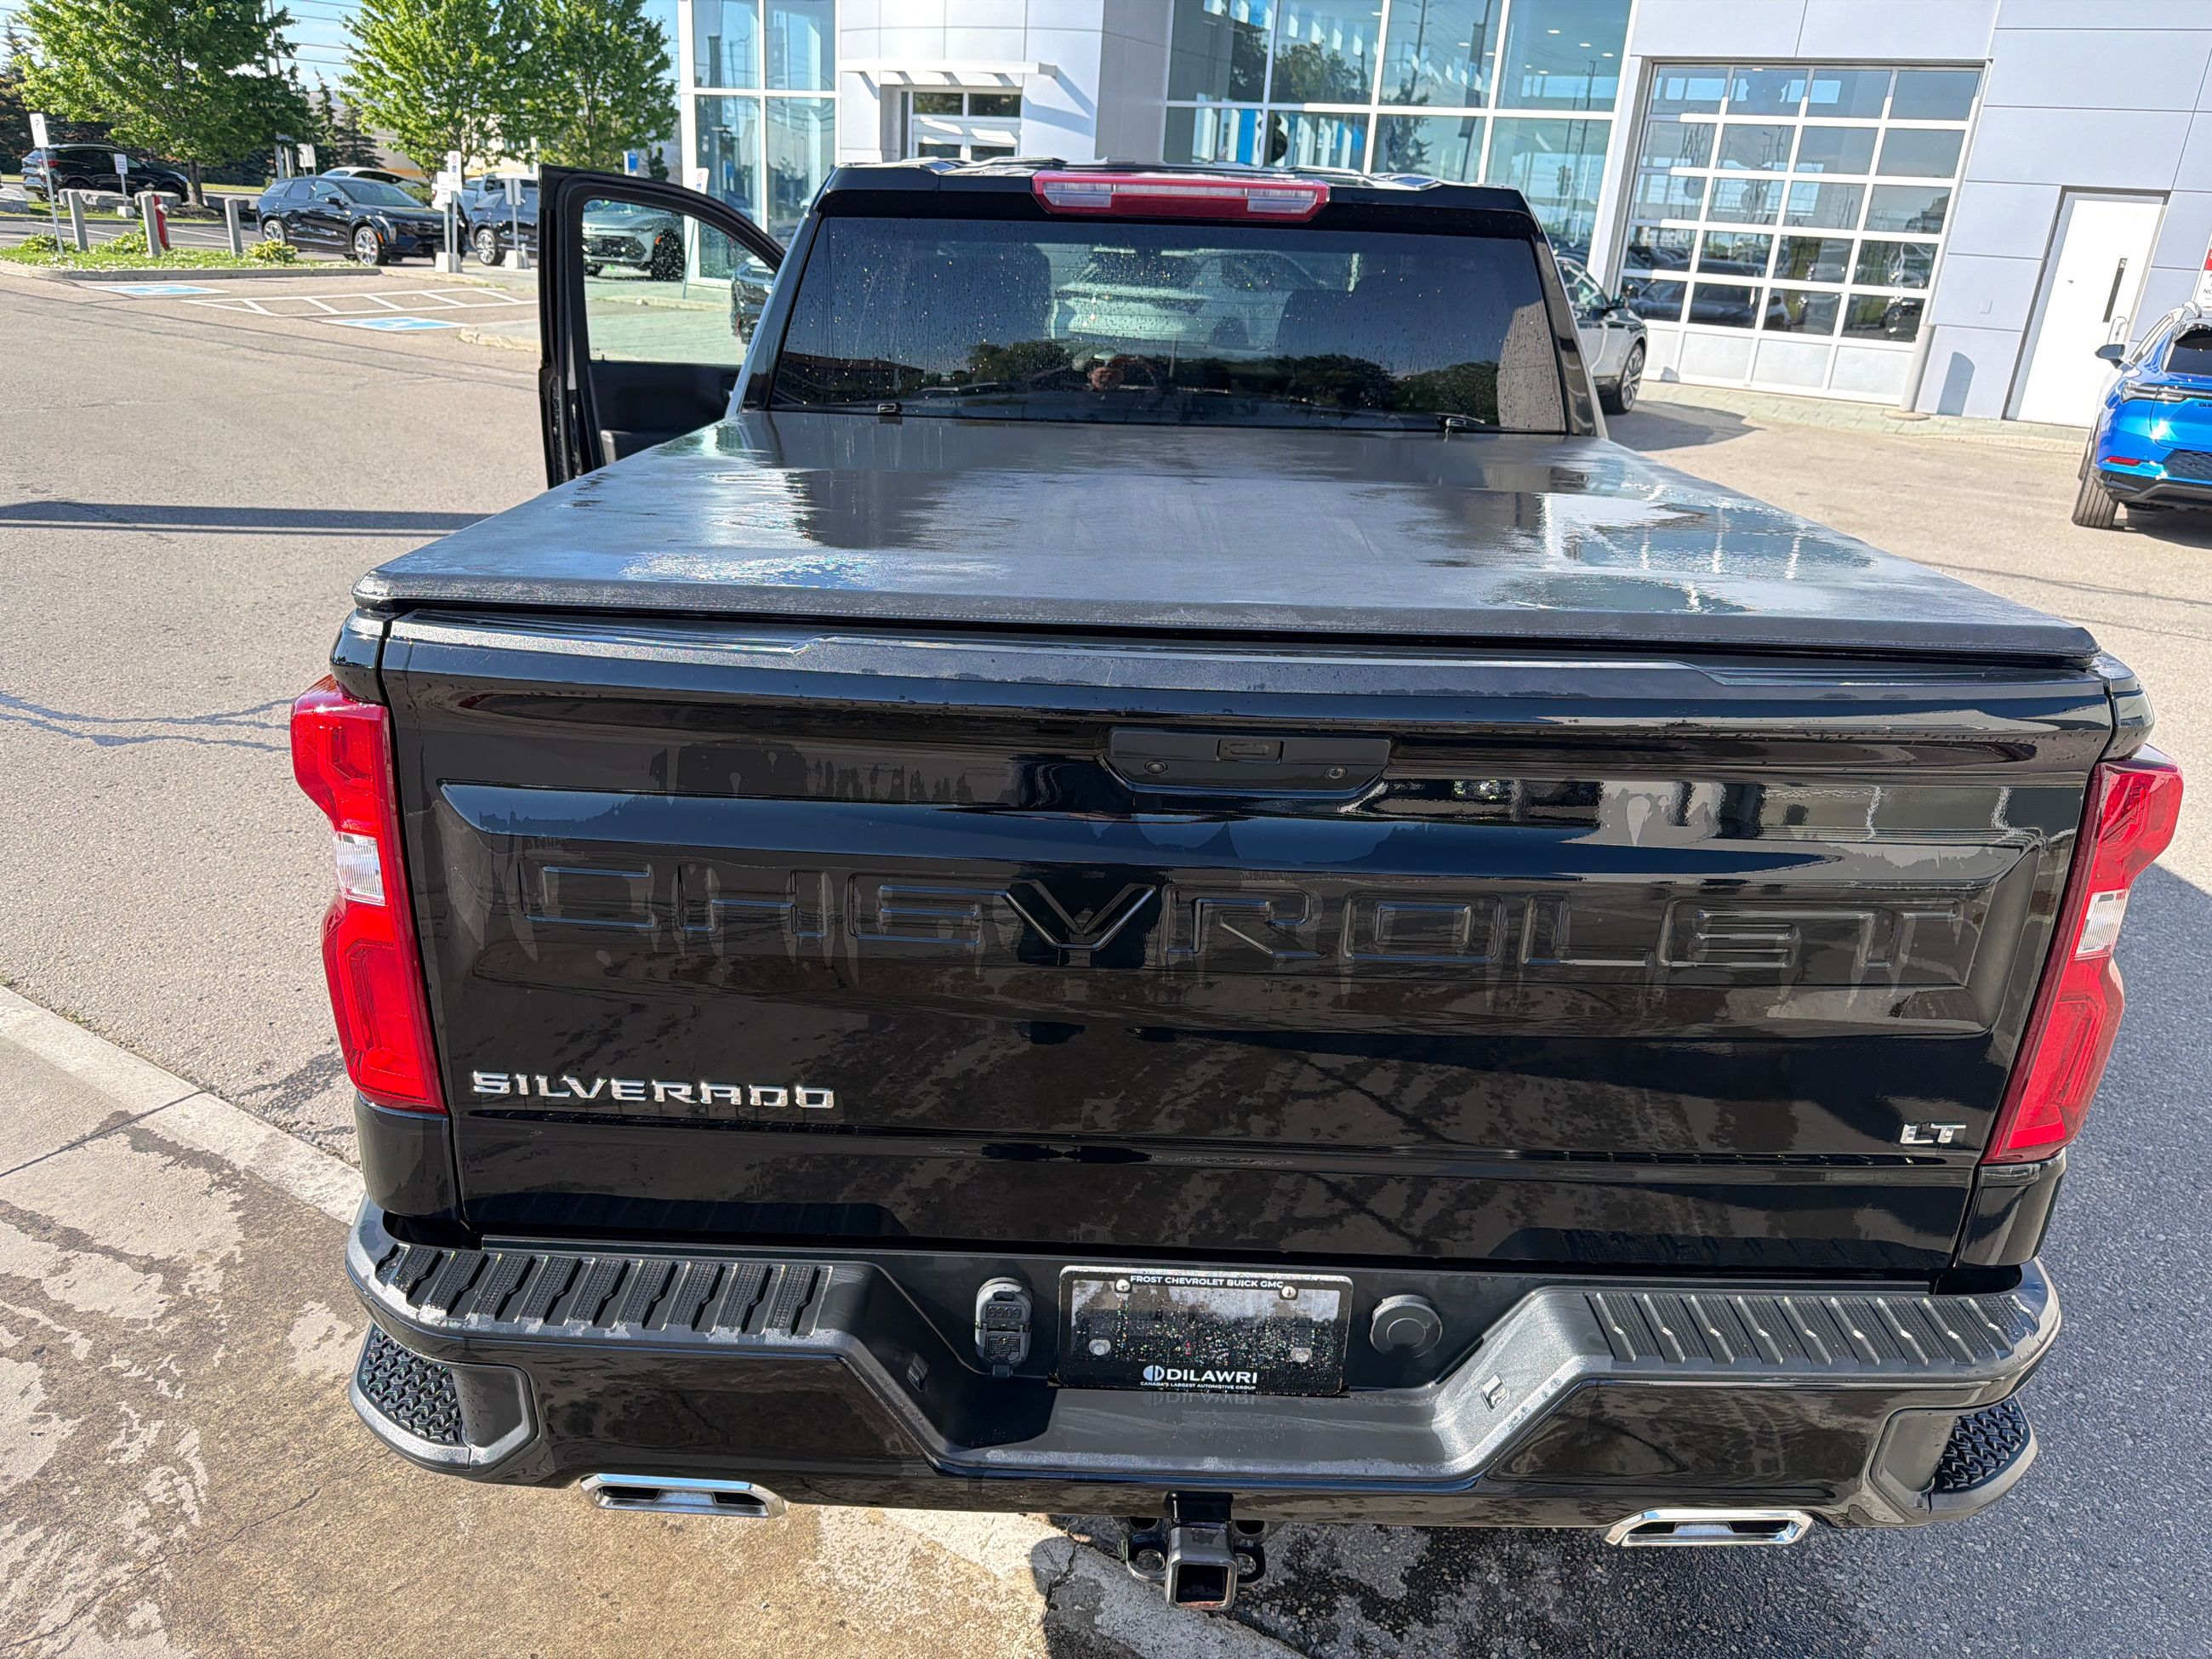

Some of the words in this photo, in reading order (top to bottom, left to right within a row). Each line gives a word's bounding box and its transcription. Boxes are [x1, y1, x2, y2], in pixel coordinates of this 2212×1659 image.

[516, 854, 1959, 969] CHEVROLET
[471, 1069, 835, 1109] SILVERADO
[1900, 1122, 1967, 1144] LT
[1130, 1274, 1164, 1284] FROST
[1165, 1276, 1225, 1286] CHEVROLET
[1226, 1279, 1258, 1287] BUICK
[1260, 1280, 1284, 1289] GMC
[1166, 1368, 1258, 1384] DILAWRI
